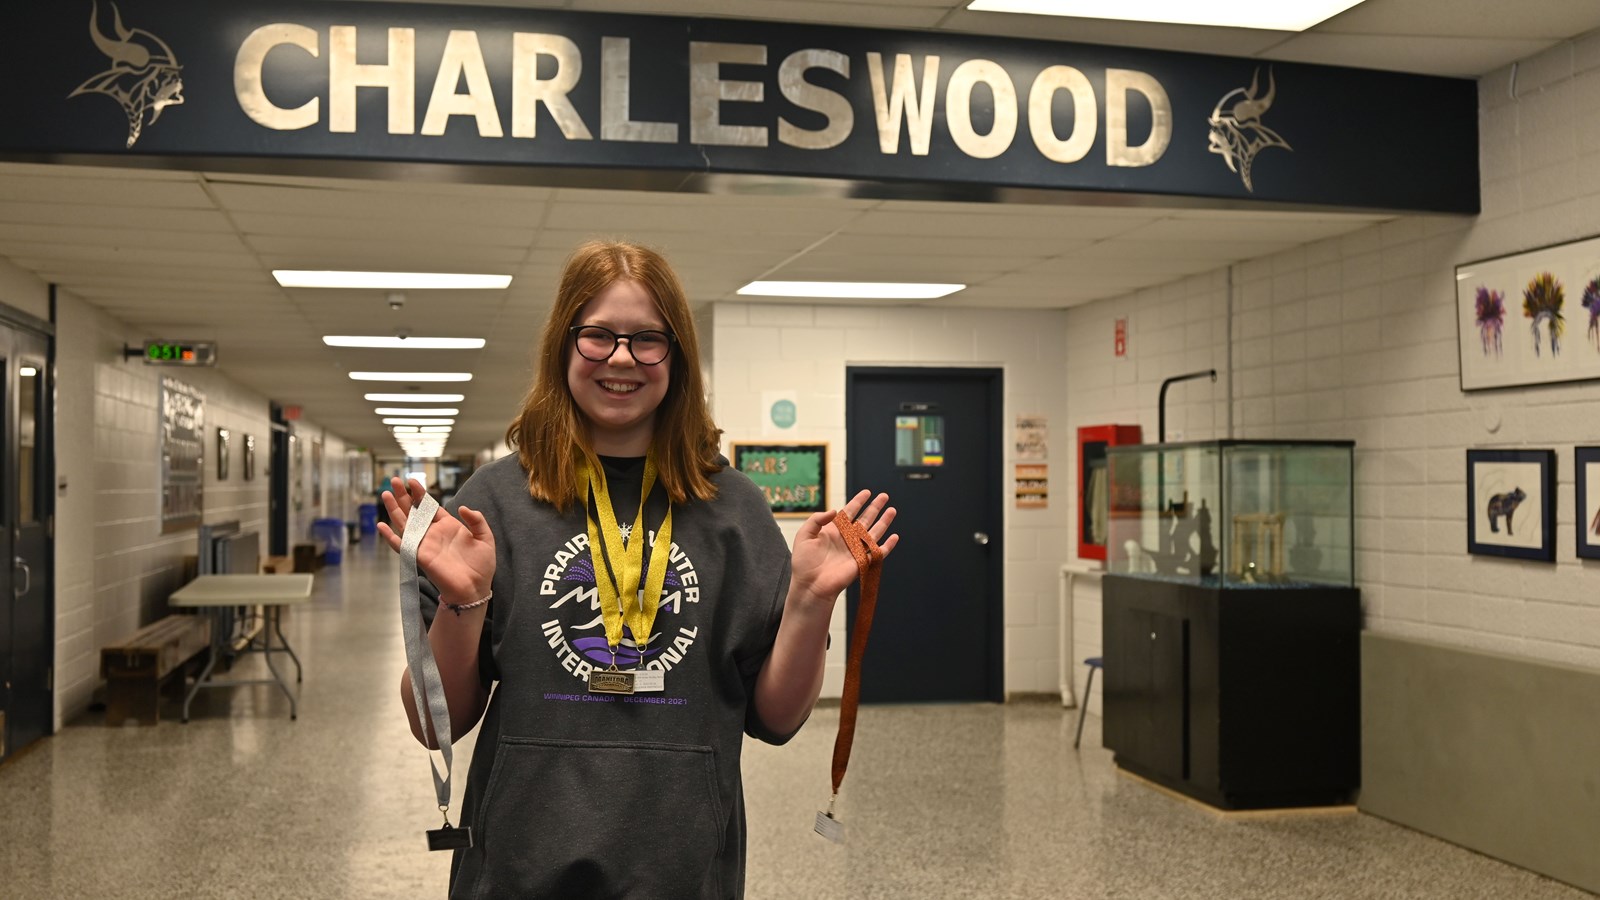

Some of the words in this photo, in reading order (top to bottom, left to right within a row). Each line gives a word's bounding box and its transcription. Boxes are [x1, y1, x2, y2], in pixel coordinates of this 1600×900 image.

[233, 22, 1172, 168] CHARLESWOOD
[543, 693, 580, 702] WINNIPEG
[581, 694, 616, 703] CANADA
[623, 696, 667, 705] DECEMBER
[668, 698, 688, 706] 2021
